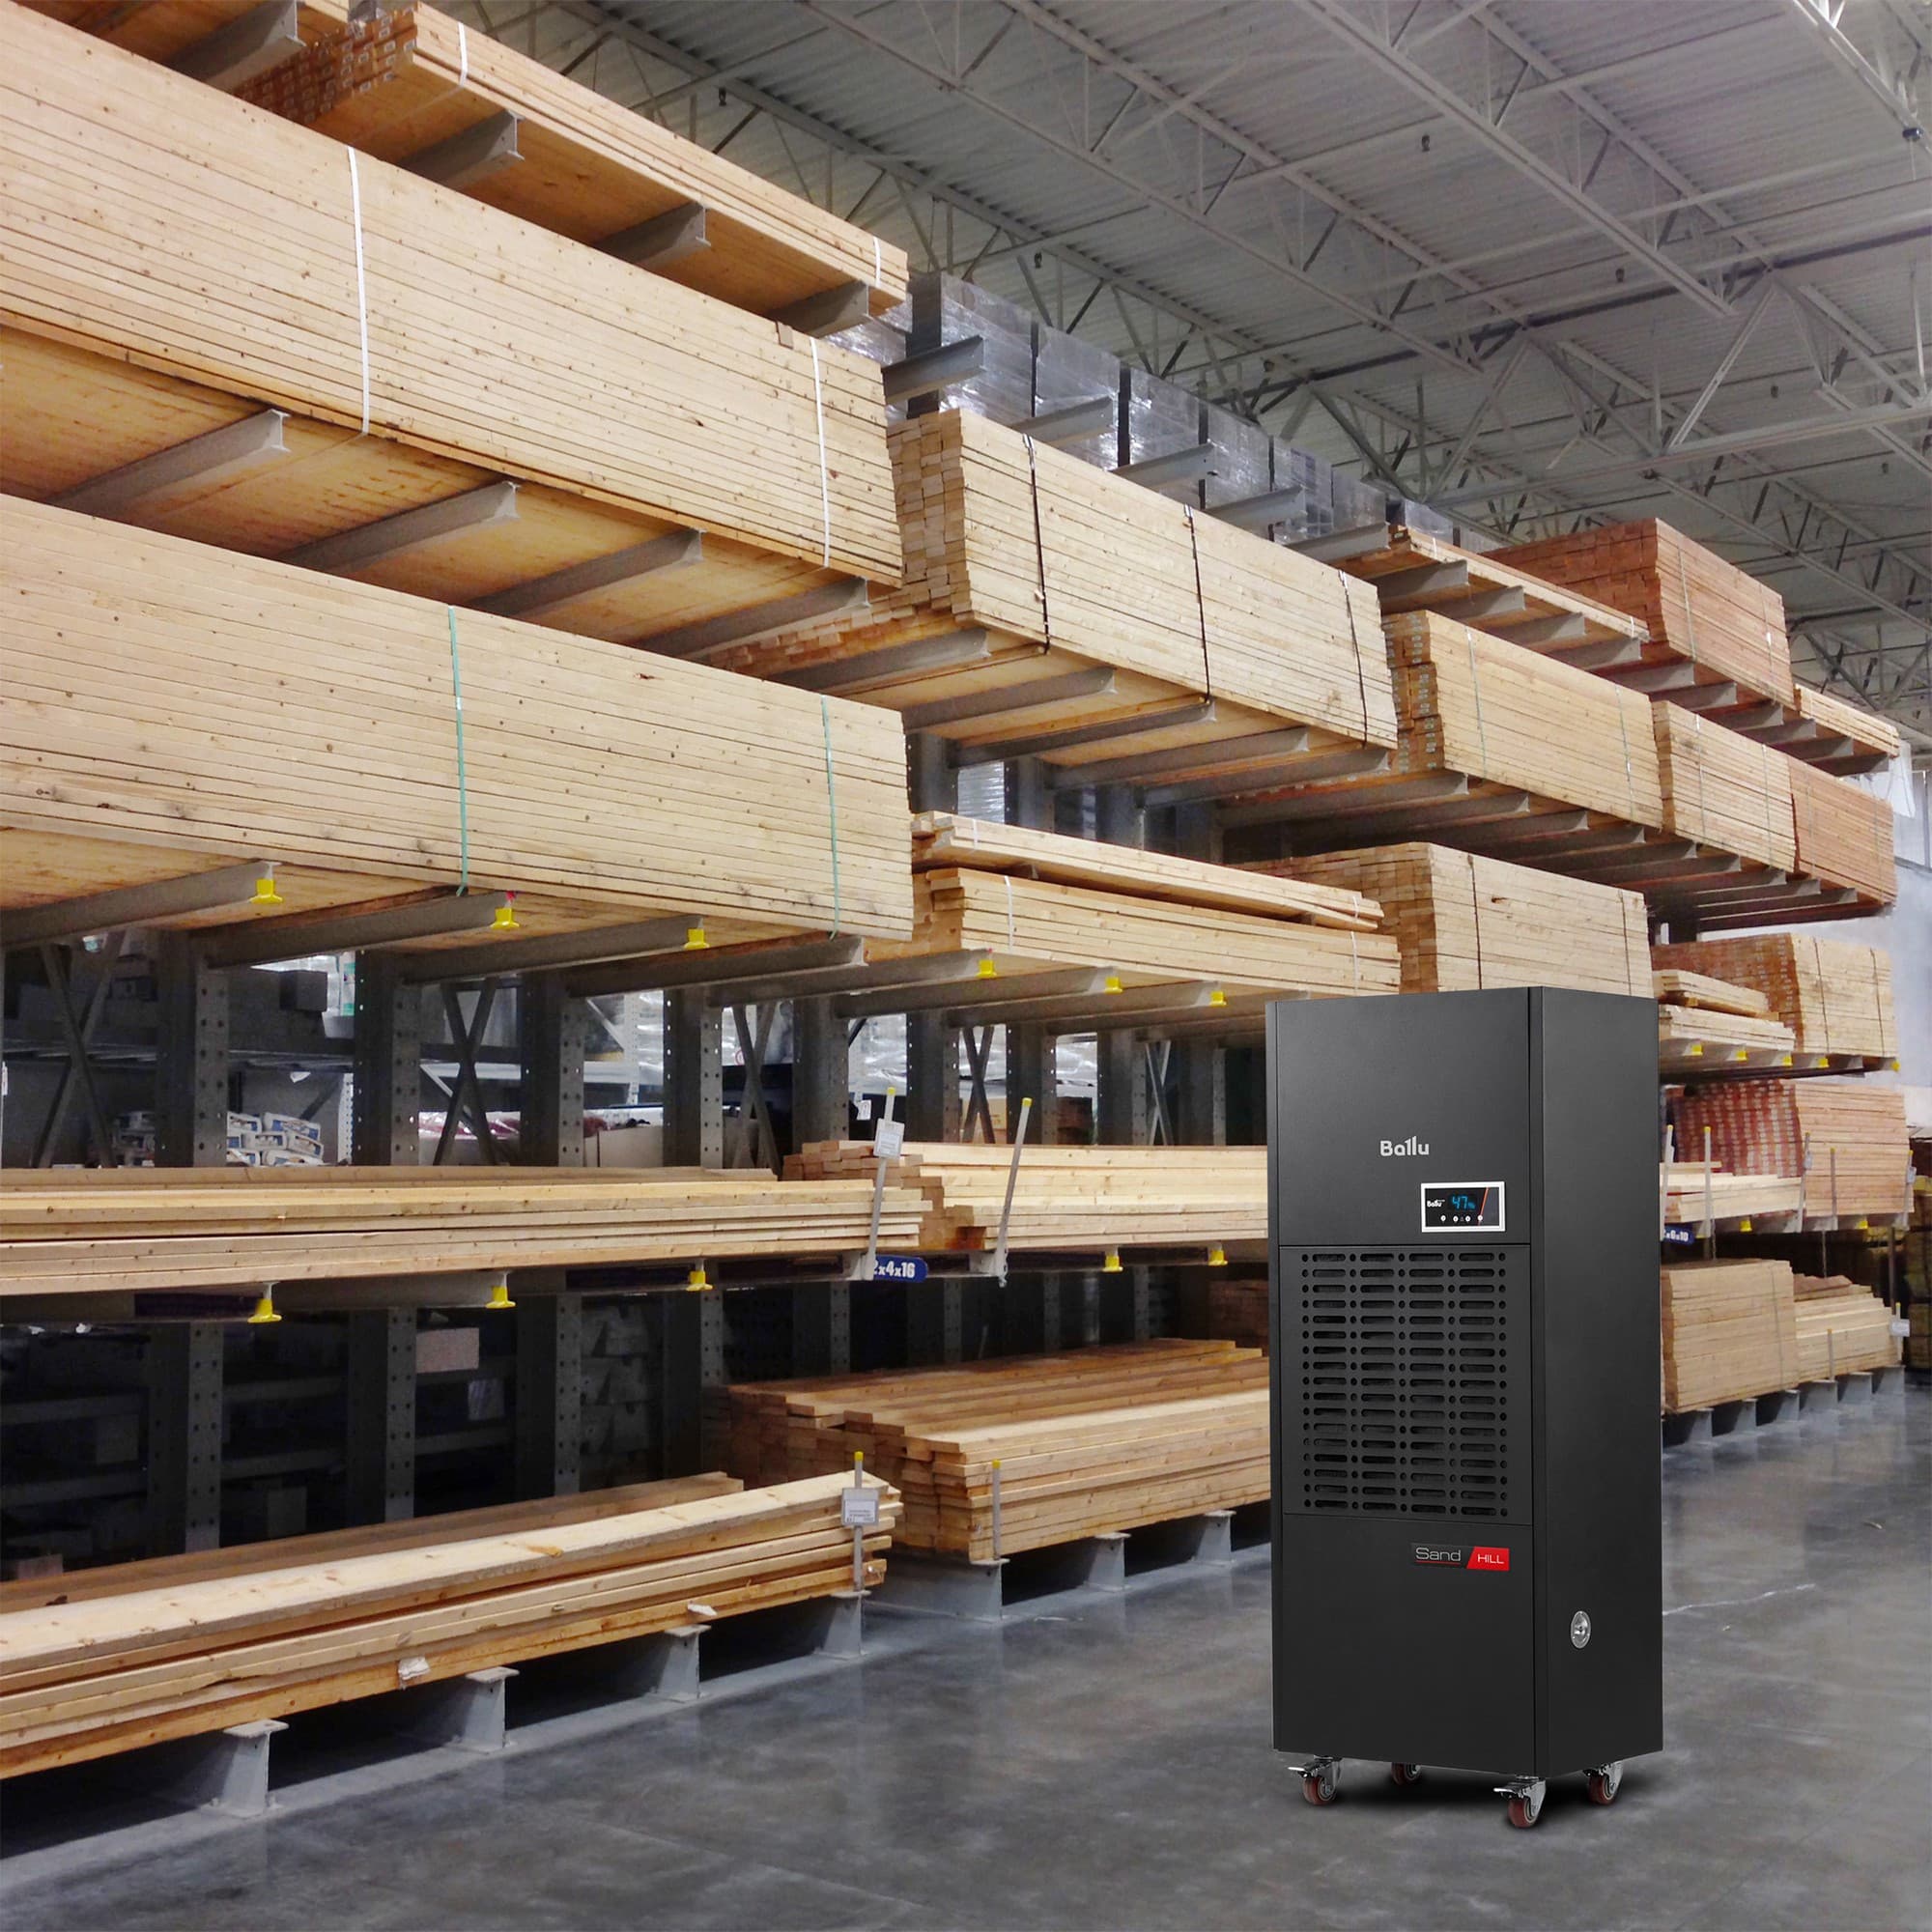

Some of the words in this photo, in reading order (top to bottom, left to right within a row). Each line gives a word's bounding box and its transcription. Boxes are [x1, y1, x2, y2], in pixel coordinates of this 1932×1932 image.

[1380, 1136, 1430, 1156] Ballu
[1415, 1547, 1462, 1562] Sand
[1477, 1553, 1504, 1564] HILL
